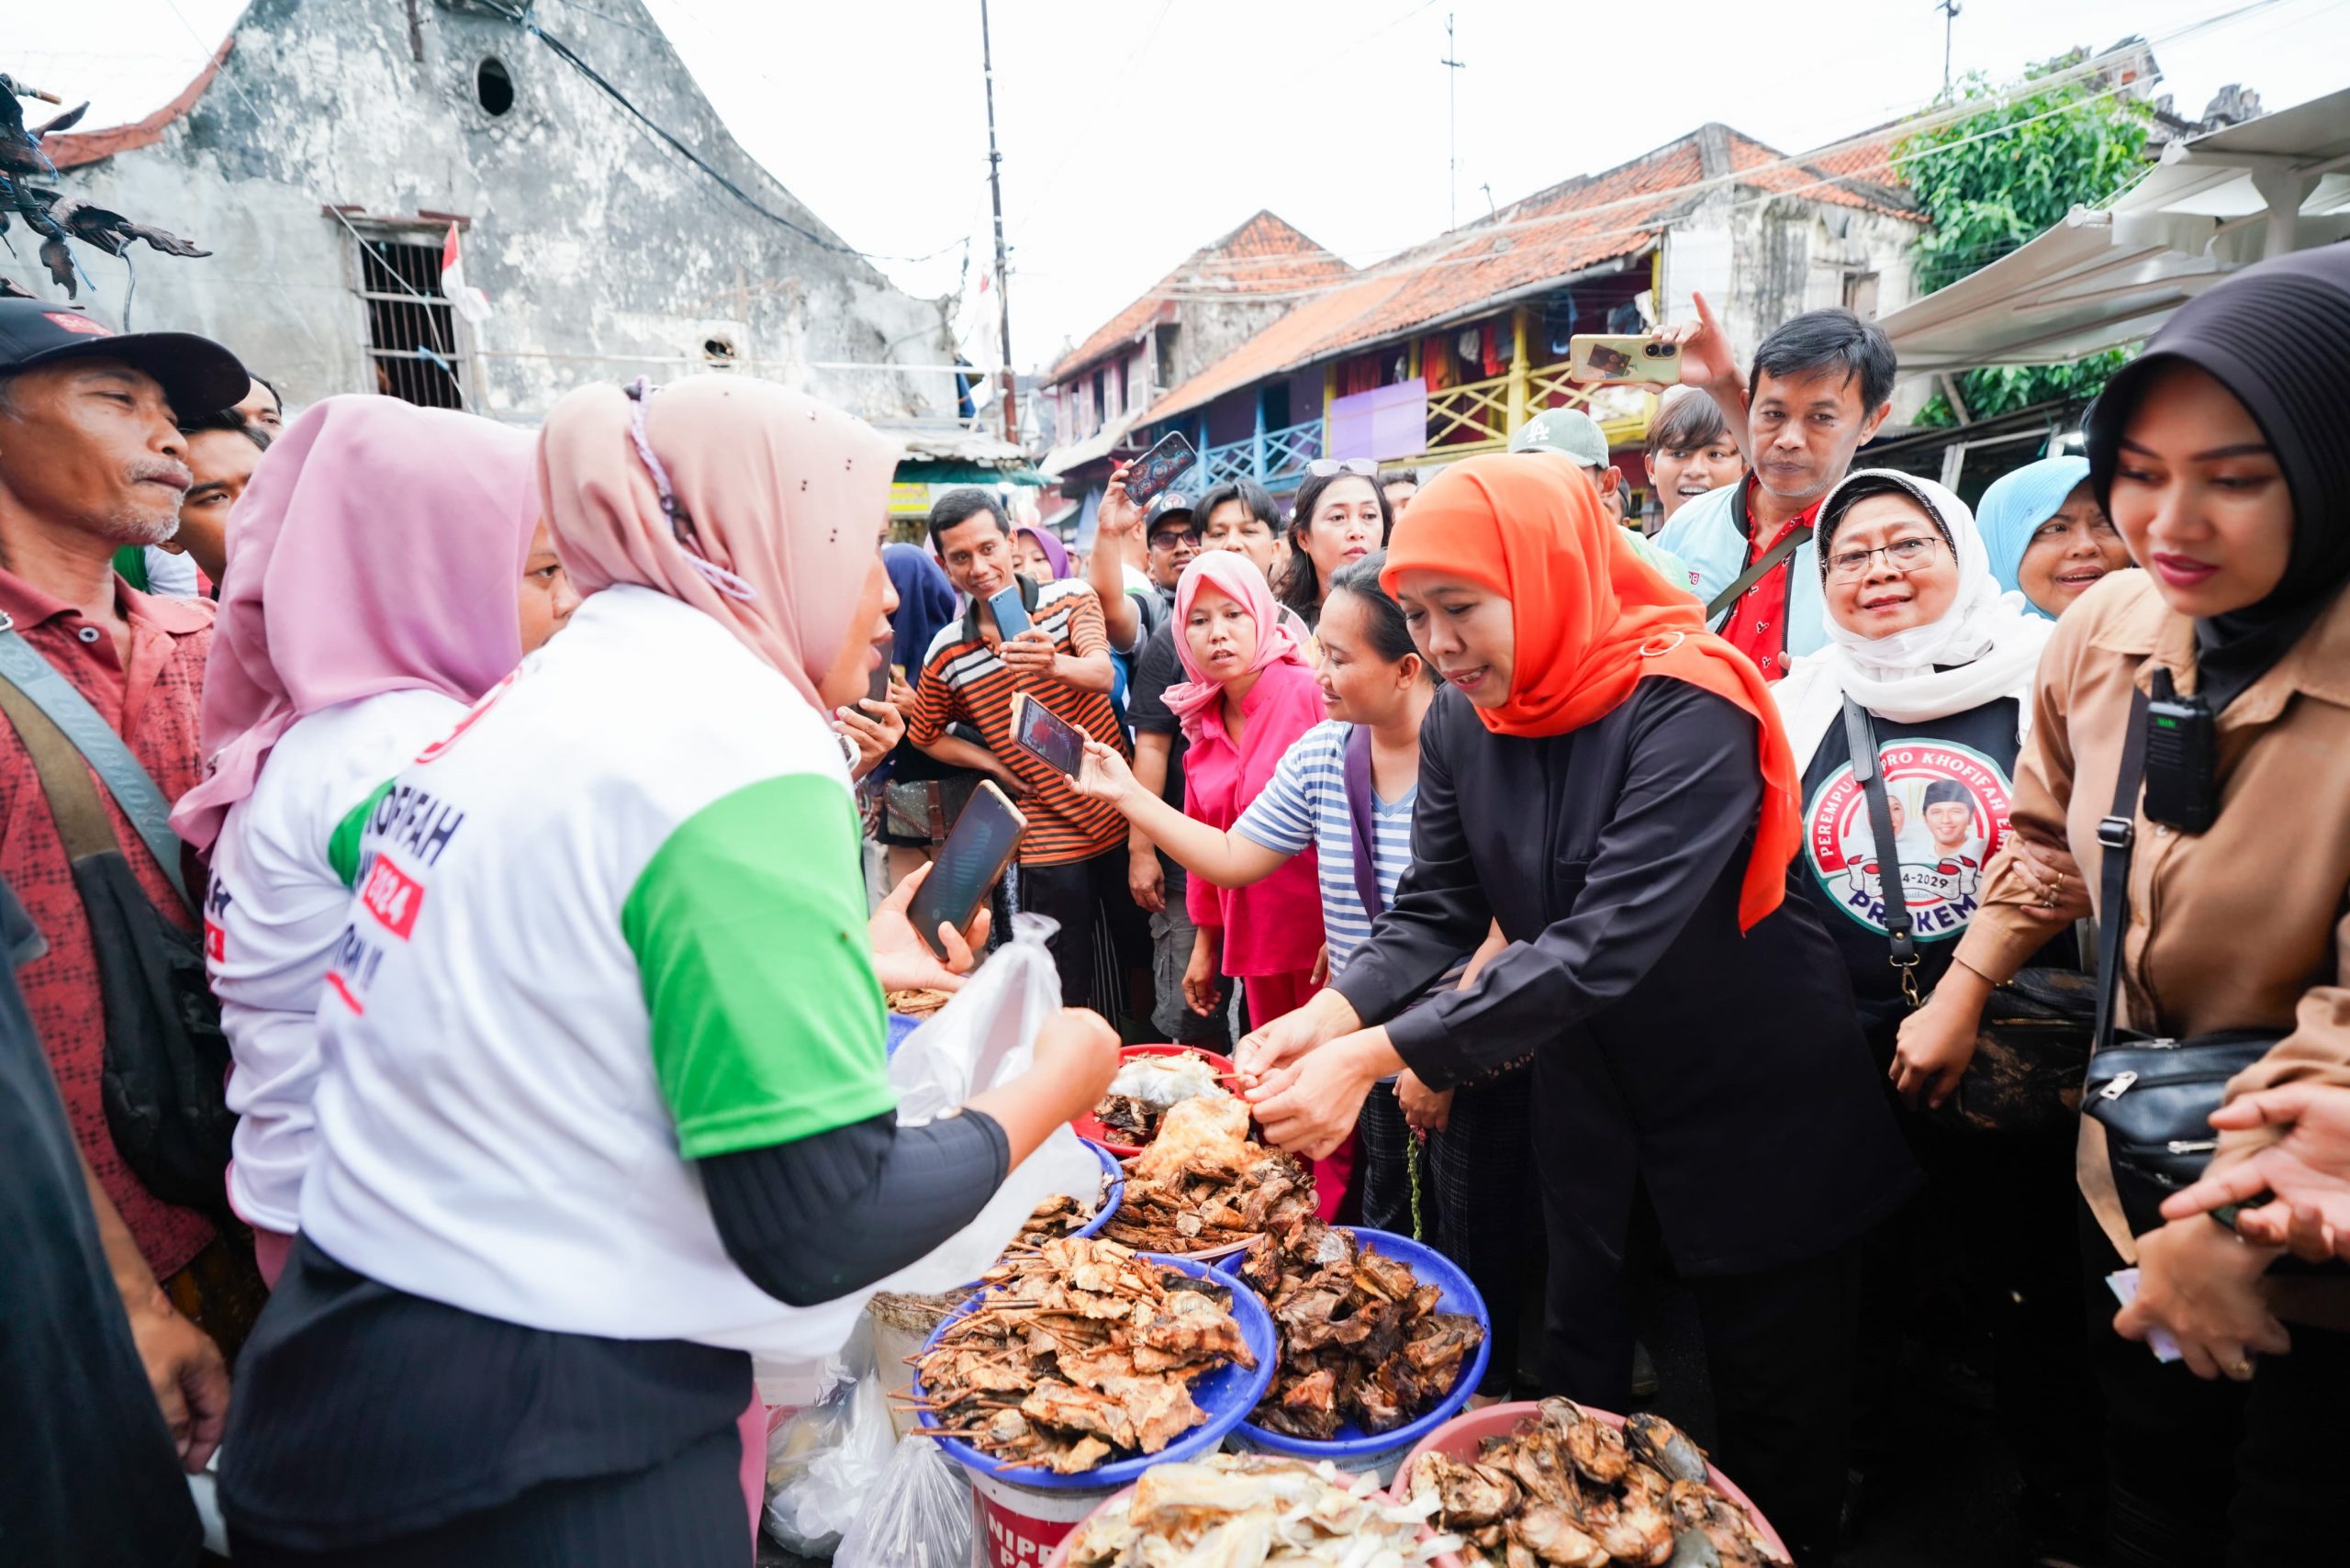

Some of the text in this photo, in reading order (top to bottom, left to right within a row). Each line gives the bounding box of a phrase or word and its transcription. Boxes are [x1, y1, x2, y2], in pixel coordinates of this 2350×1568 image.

[1818, 775, 1858, 857] PEREMPU
[1881, 751, 1914, 772] PRO
[1921, 752, 2007, 812] KHOFIFAH
[988, 1510, 1058, 1568] NIPP
